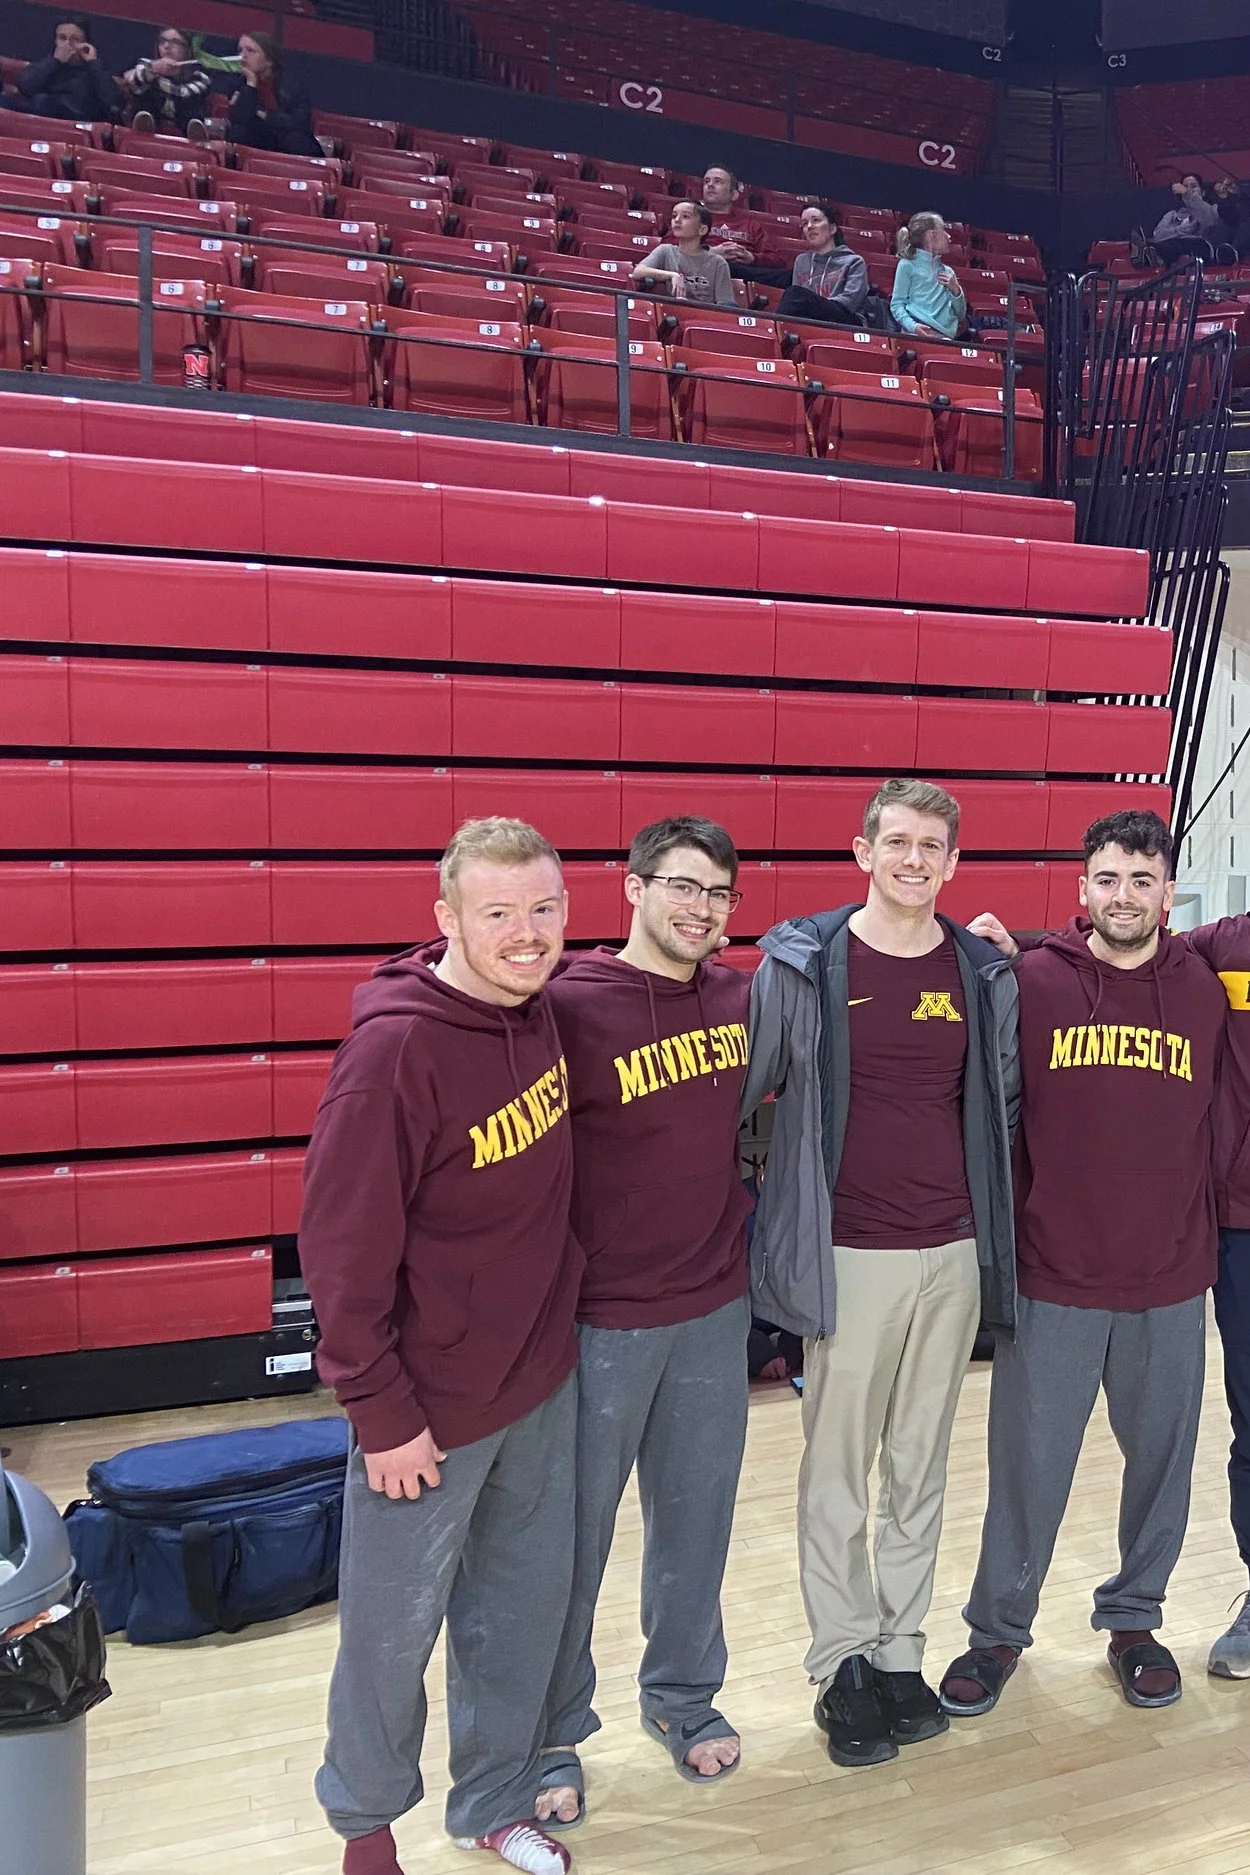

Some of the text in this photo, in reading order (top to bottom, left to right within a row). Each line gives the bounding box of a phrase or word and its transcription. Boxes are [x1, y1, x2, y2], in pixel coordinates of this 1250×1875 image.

[983, 47, 1001, 62] C2
[1108, 55, 1126, 67] C3
[619, 83, 664, 113] C2
[918, 141, 956, 169] C2
[184, 354, 209, 377] N
[1049, 1024, 1193, 1082] MINNESOTA
